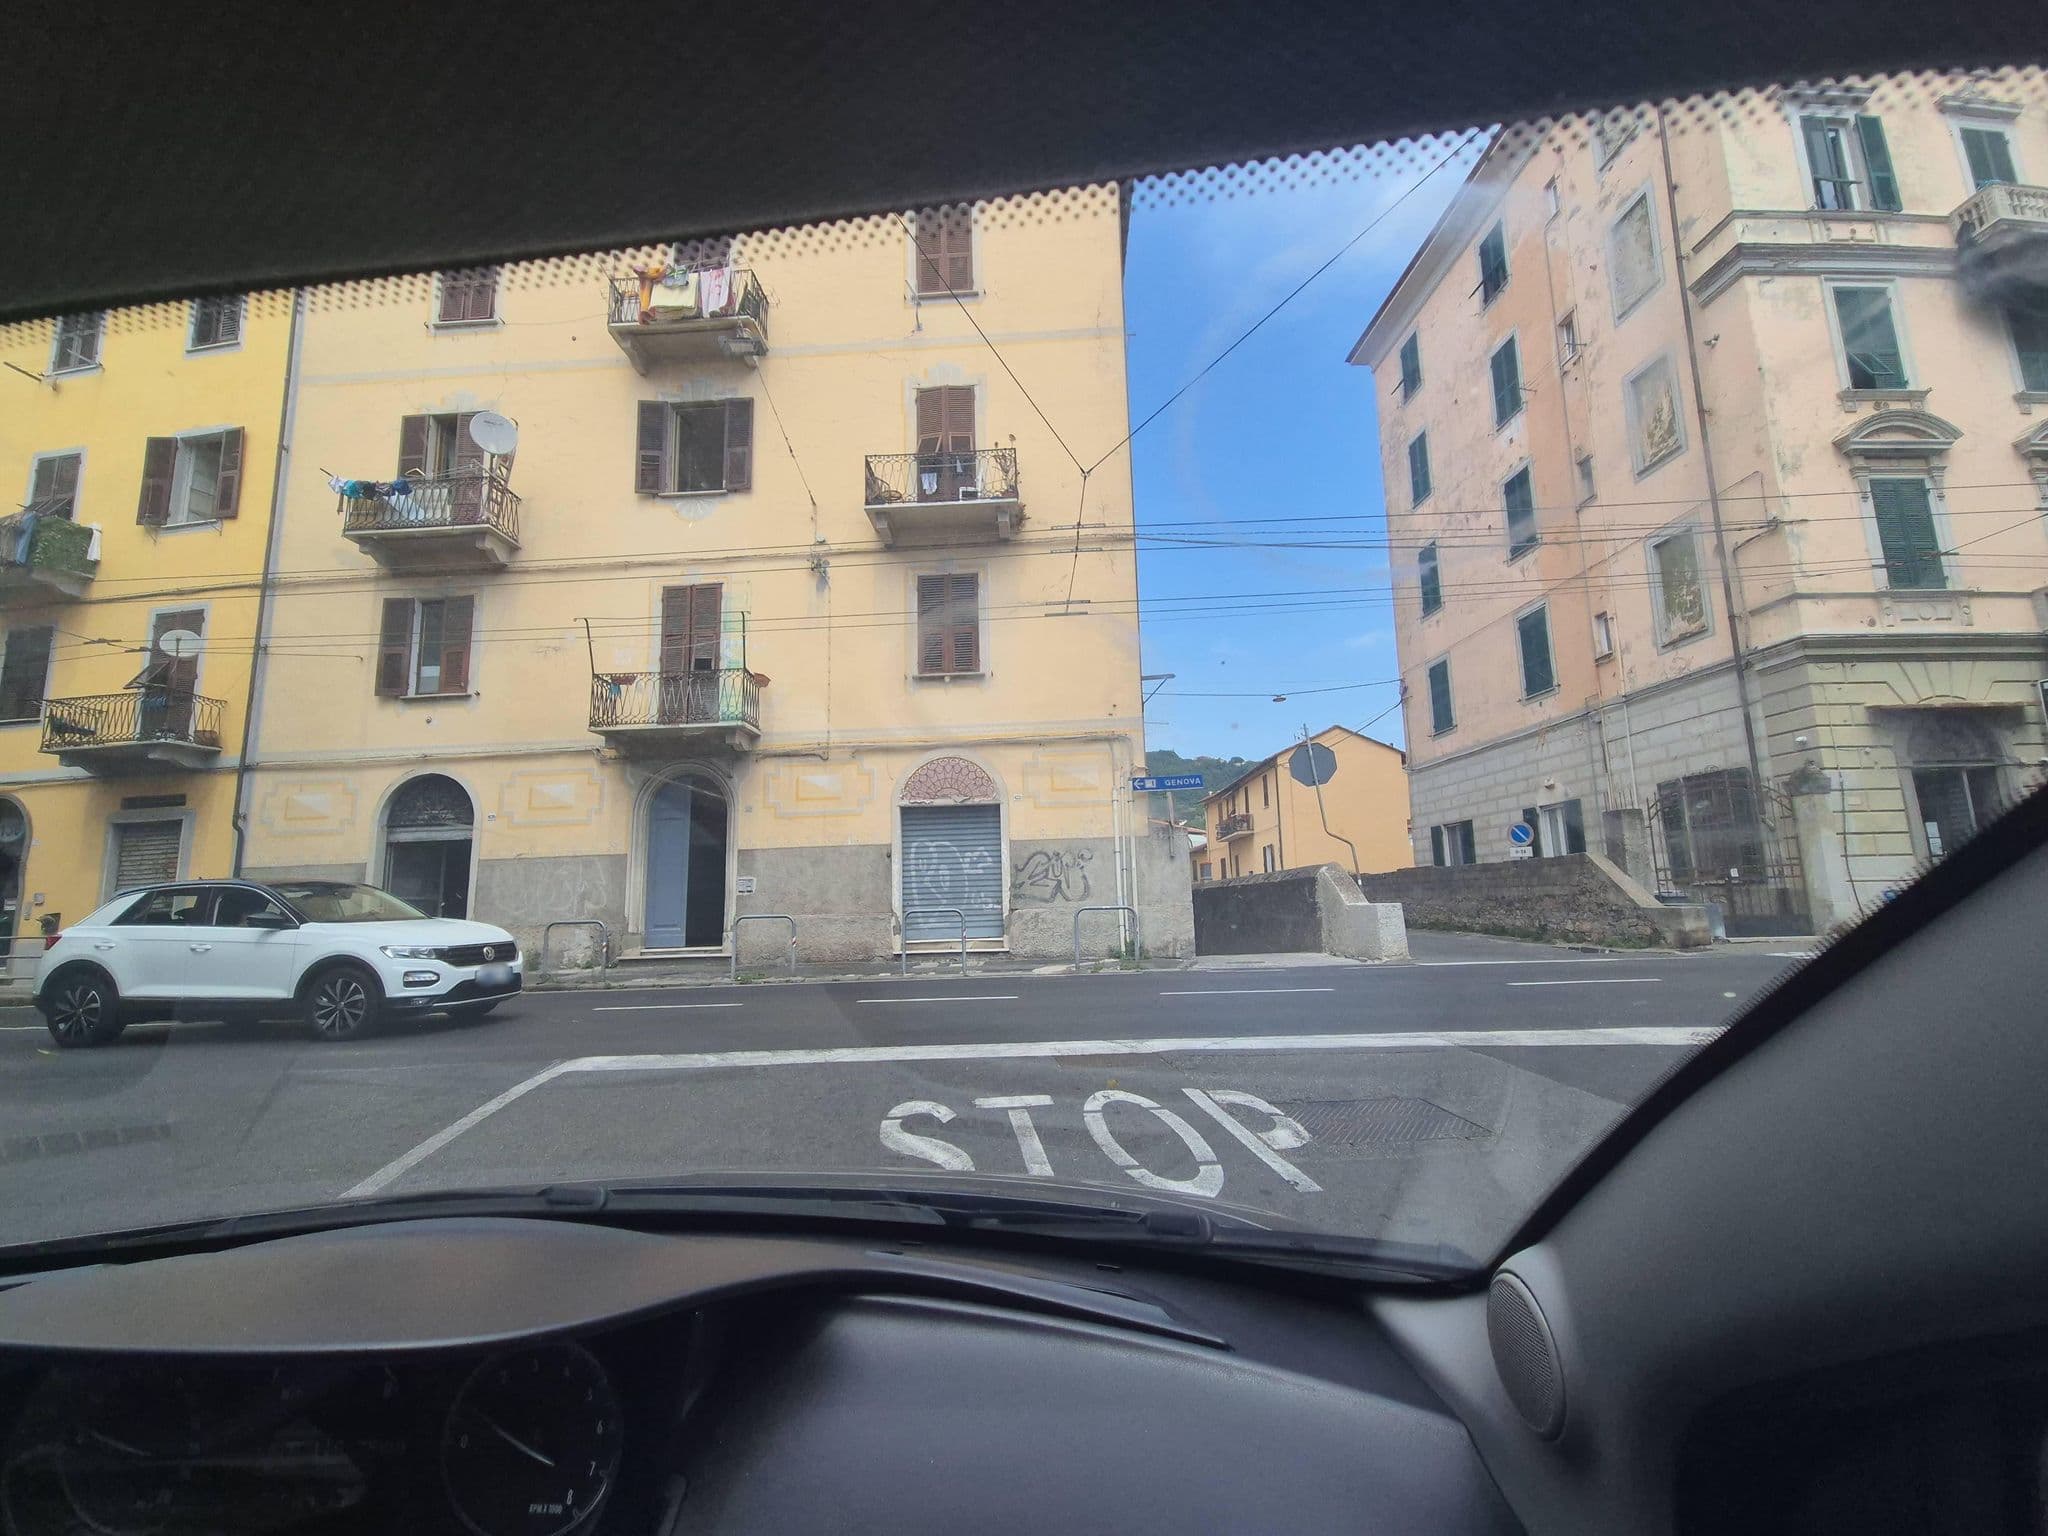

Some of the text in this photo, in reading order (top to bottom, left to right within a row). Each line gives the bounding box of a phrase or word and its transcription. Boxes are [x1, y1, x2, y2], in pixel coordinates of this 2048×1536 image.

[1164, 778, 1201, 786] GENOVA
[880, 1088, 1323, 1198] STOP
[589, 1461, 597, 1477] 7
[566, 1488, 574, 1505] 8
